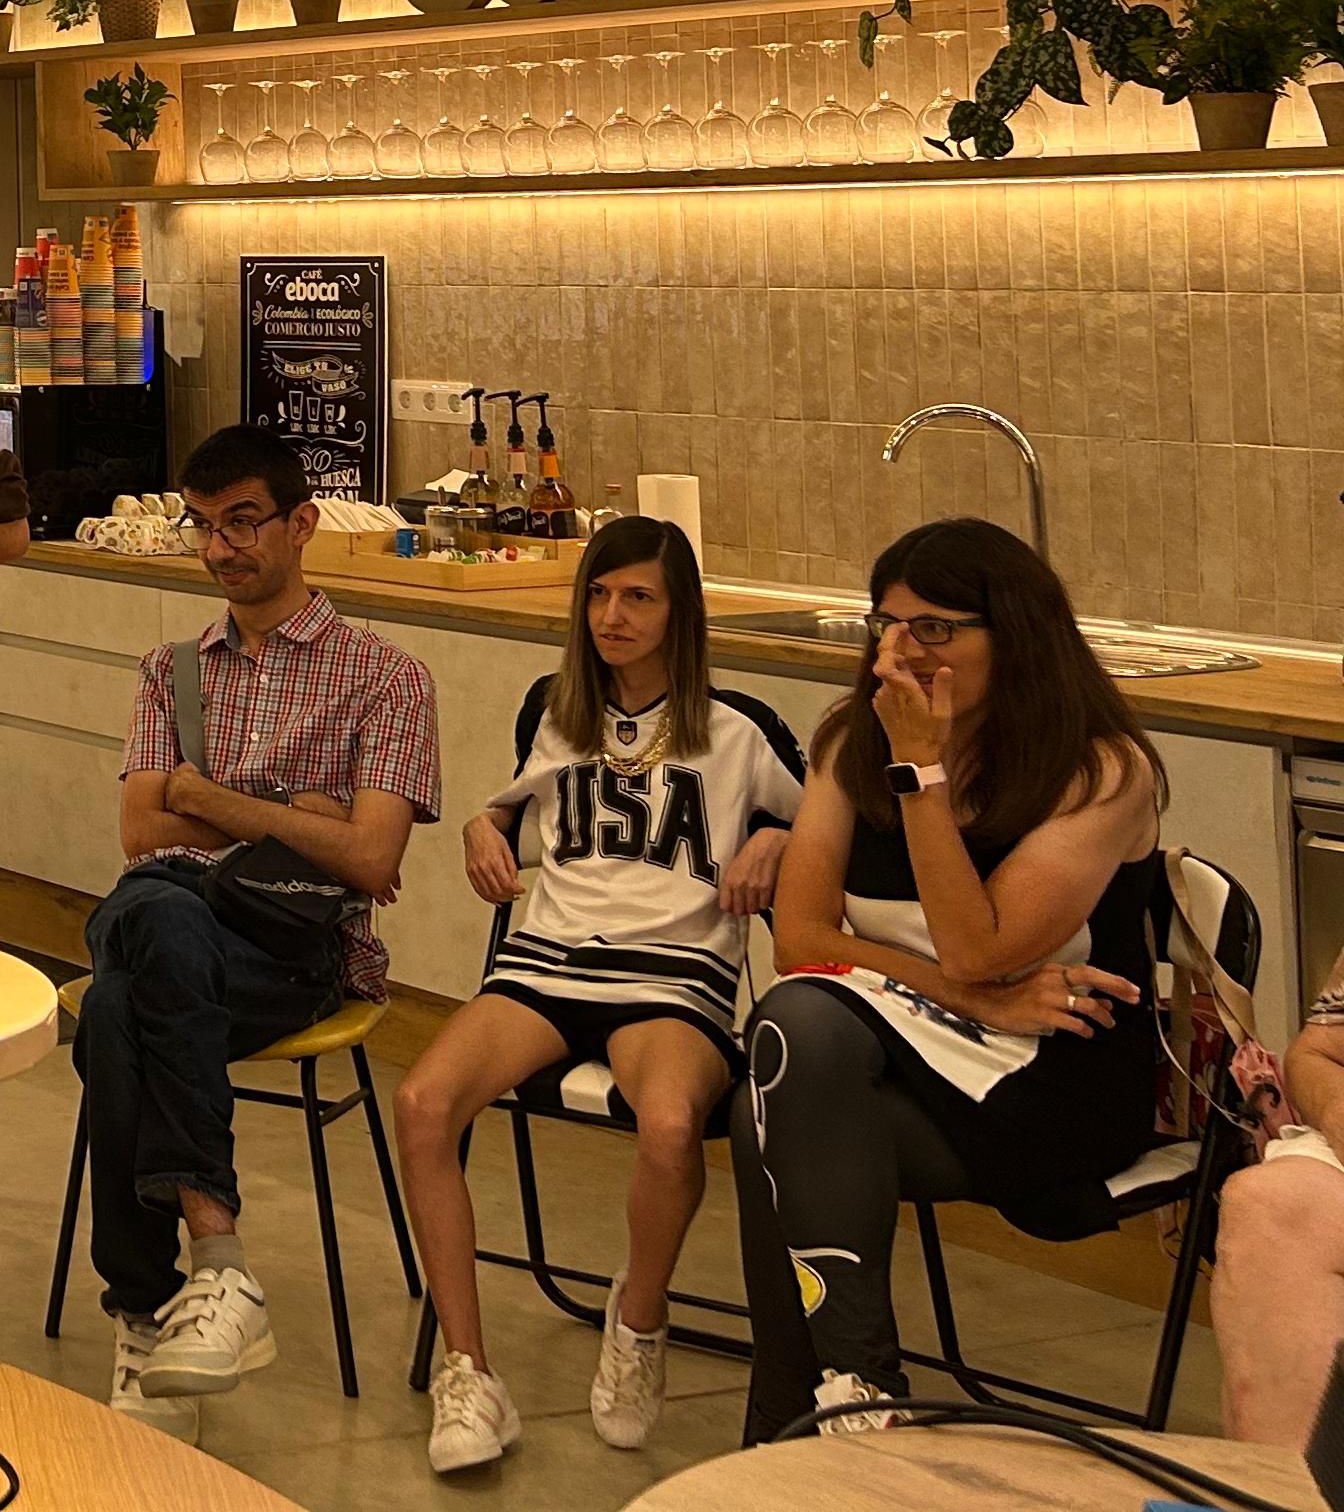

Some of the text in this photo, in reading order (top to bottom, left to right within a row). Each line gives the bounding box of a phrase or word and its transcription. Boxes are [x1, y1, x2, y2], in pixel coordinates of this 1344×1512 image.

[301, 268, 323, 279] CAFÉ
[285, 276, 340, 301] eboca
[264, 304, 361, 320] Colombia ECOLÓGICO
[264, 321, 362, 337] COMERCIO JUSTO
[321, 379, 347, 392] VASO
[320, 465, 362, 487] HUESCA
[553, 759, 720, 889] USA
